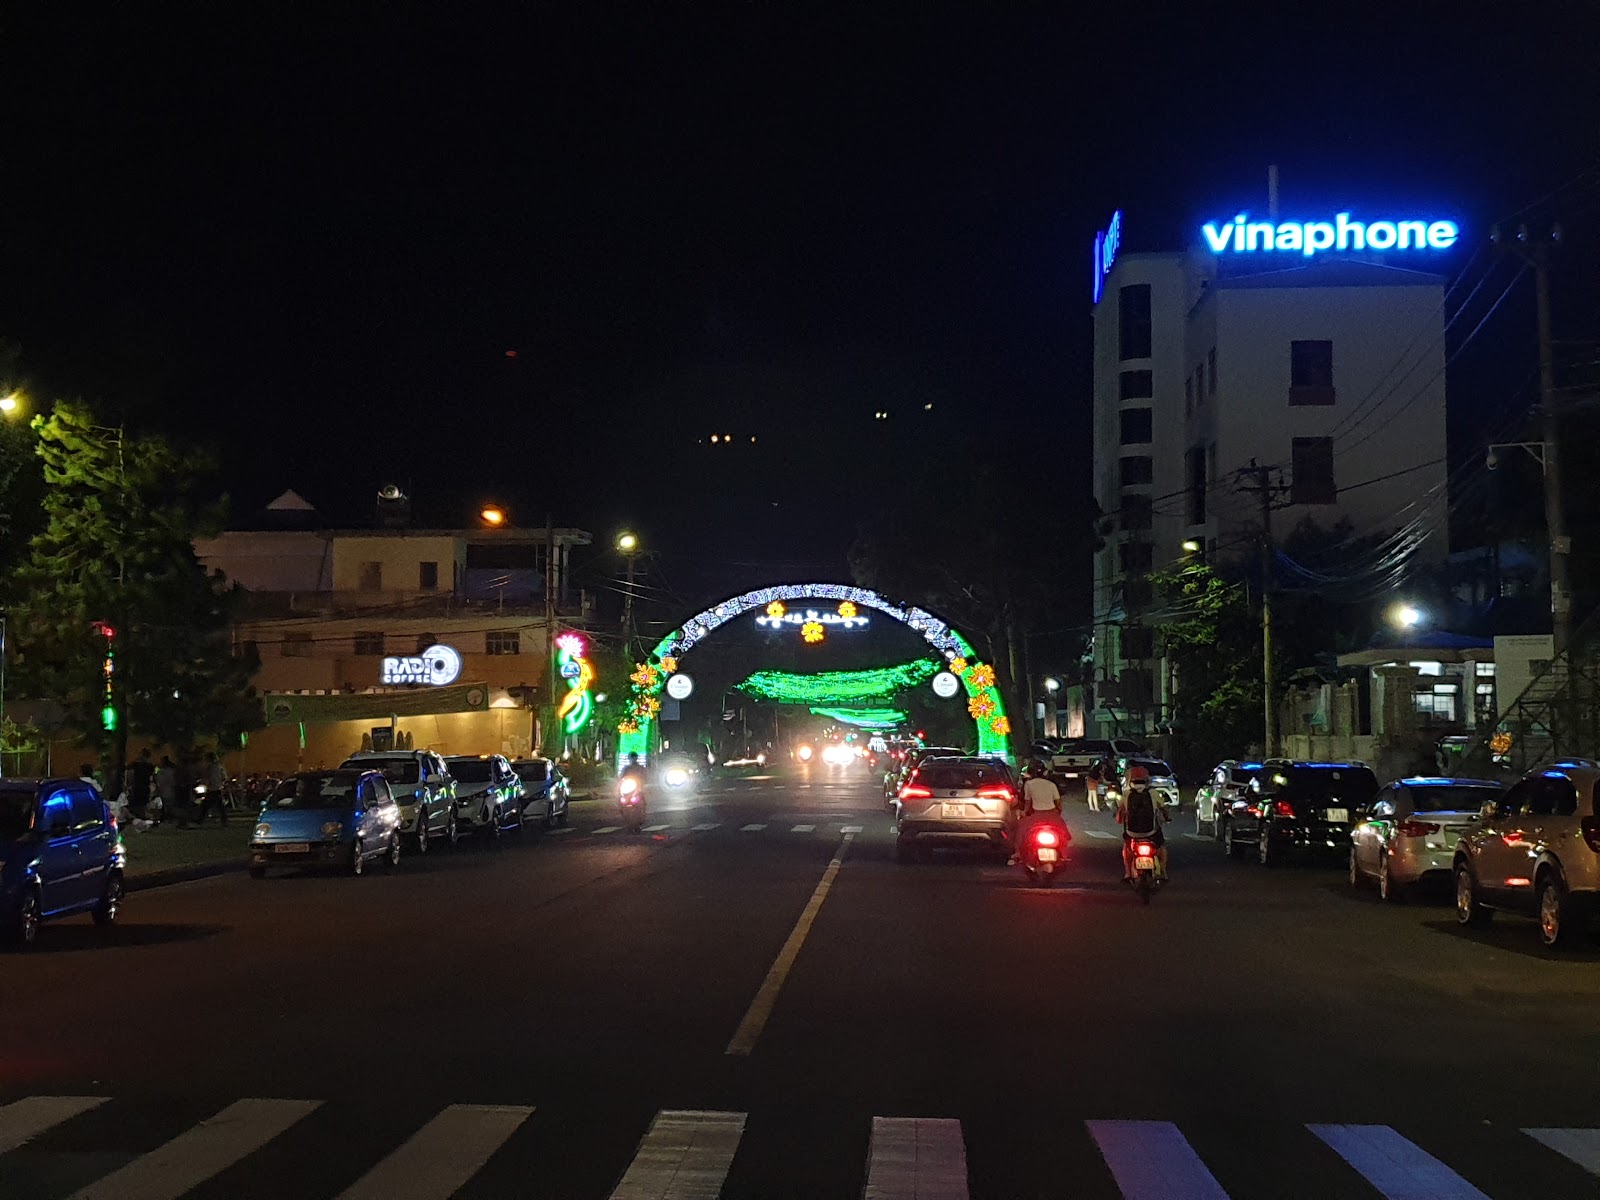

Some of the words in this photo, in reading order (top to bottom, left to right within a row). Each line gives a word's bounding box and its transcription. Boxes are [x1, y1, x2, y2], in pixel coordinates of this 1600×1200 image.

[1202, 212, 1459, 256] vinaphone
[383, 645, 461, 686] RADIO
[383, 674, 431, 684] COFFEE
